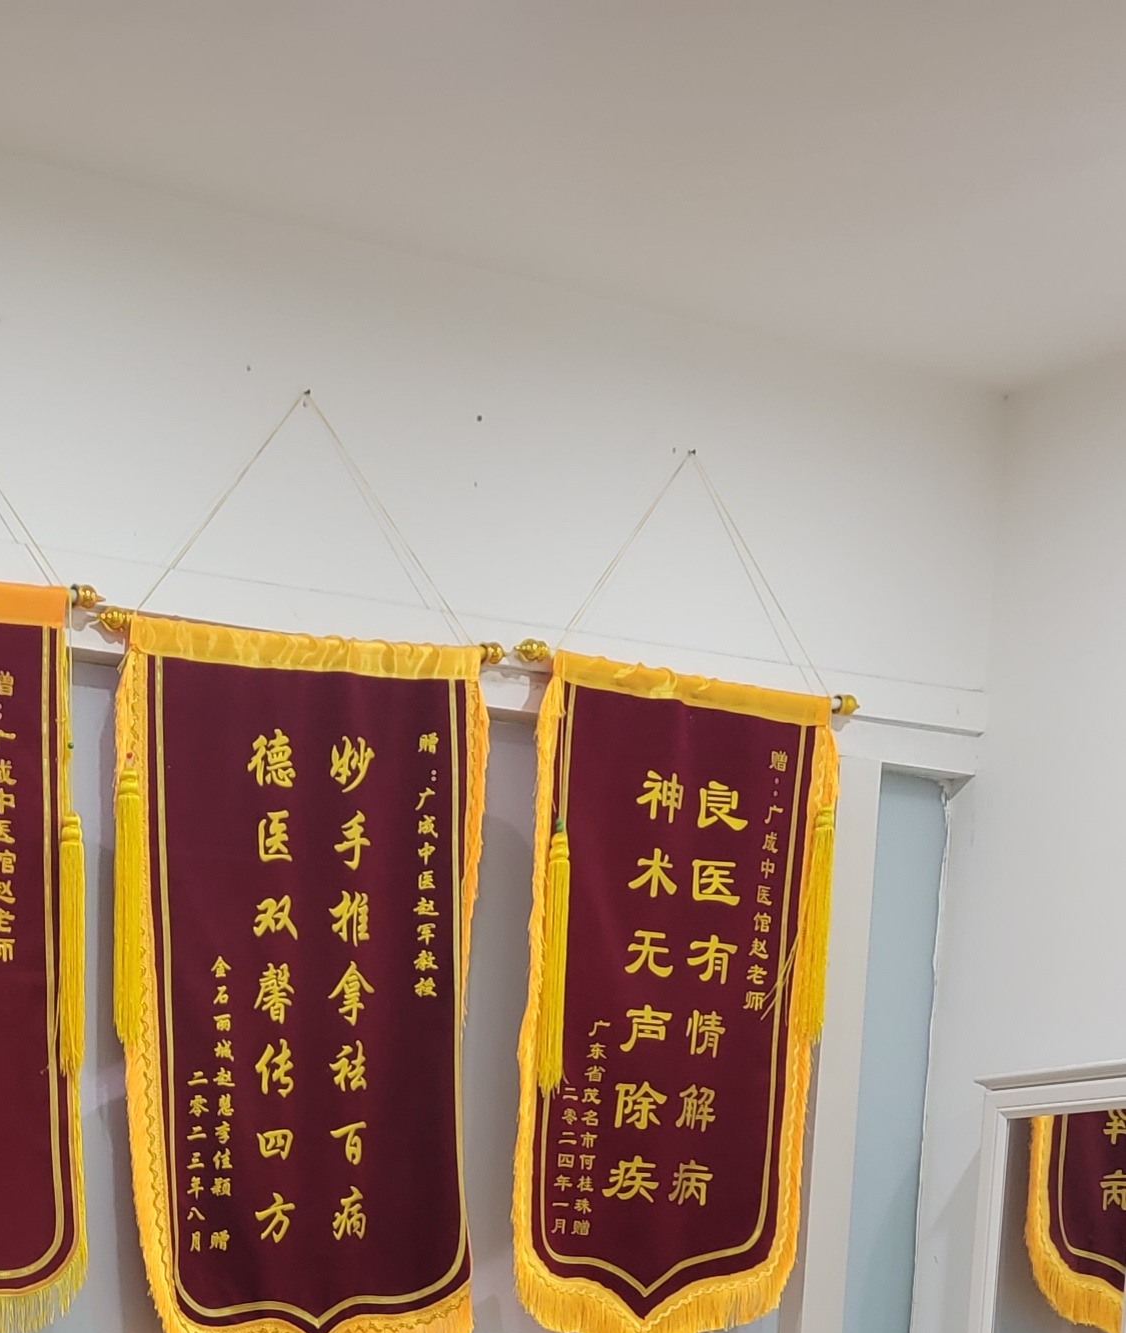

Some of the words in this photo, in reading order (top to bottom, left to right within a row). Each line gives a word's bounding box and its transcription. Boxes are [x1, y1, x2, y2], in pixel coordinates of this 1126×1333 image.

[186, 1070, 210, 1252] 二零二三年八月
[247, 728, 298, 1244] 德医双馨传四方
[327, 735, 375, 1241] 妙手推拿祛百病
[551, 1087, 579, 1234] 二零二四年一月
[571, 1020, 611, 1236] 广东省茂名市何桂珠赠
[601, 769, 684, 1203] 神术无声除疾
[668, 780, 749, 1206] 良医有情解病
